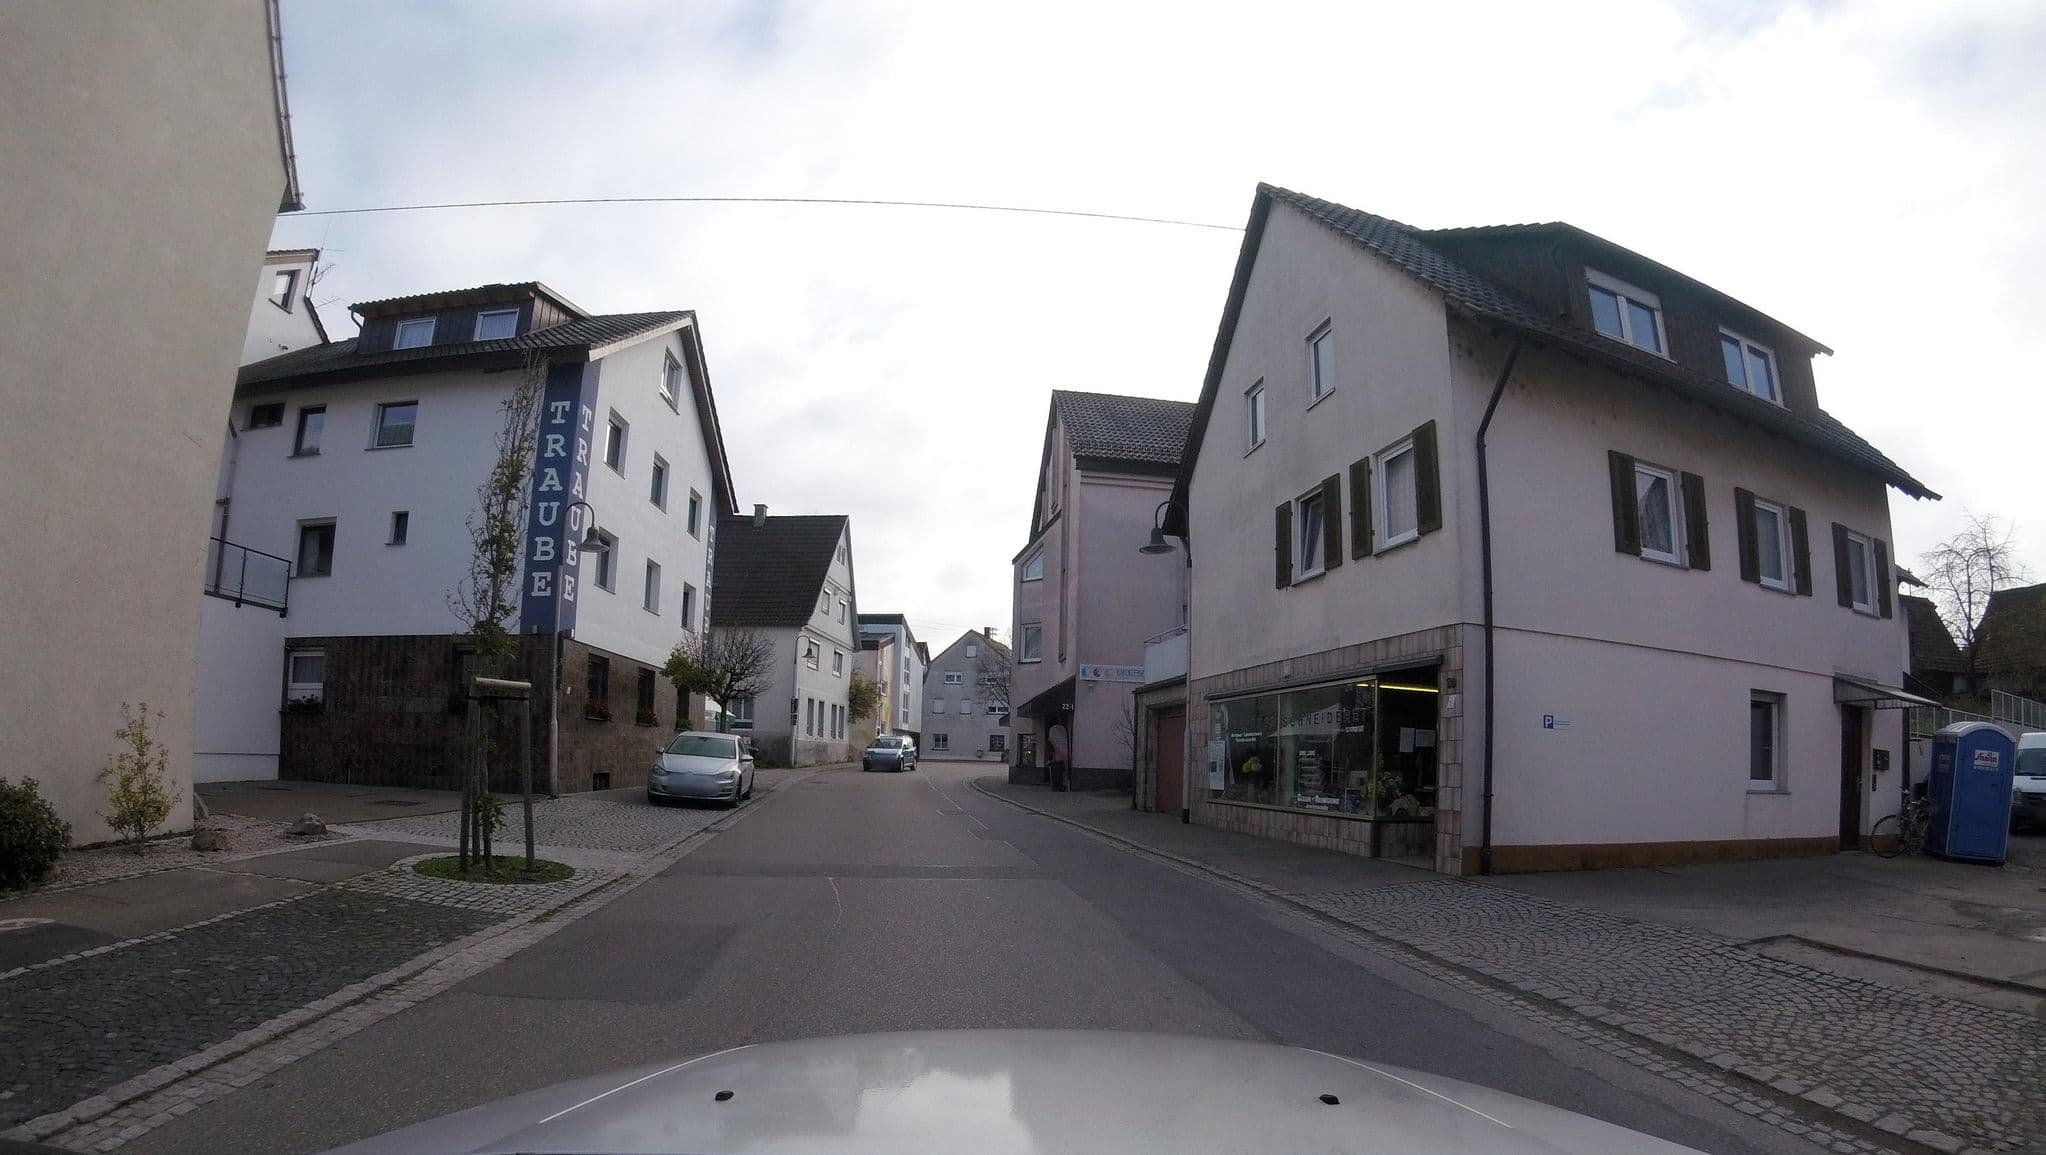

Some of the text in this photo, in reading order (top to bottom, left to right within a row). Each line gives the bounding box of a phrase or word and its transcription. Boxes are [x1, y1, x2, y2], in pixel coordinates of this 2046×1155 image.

[530, 400, 571, 598] TRAUBE
[563, 404, 593, 602] TRAUBE
[703, 525, 715, 656] TRAUB
